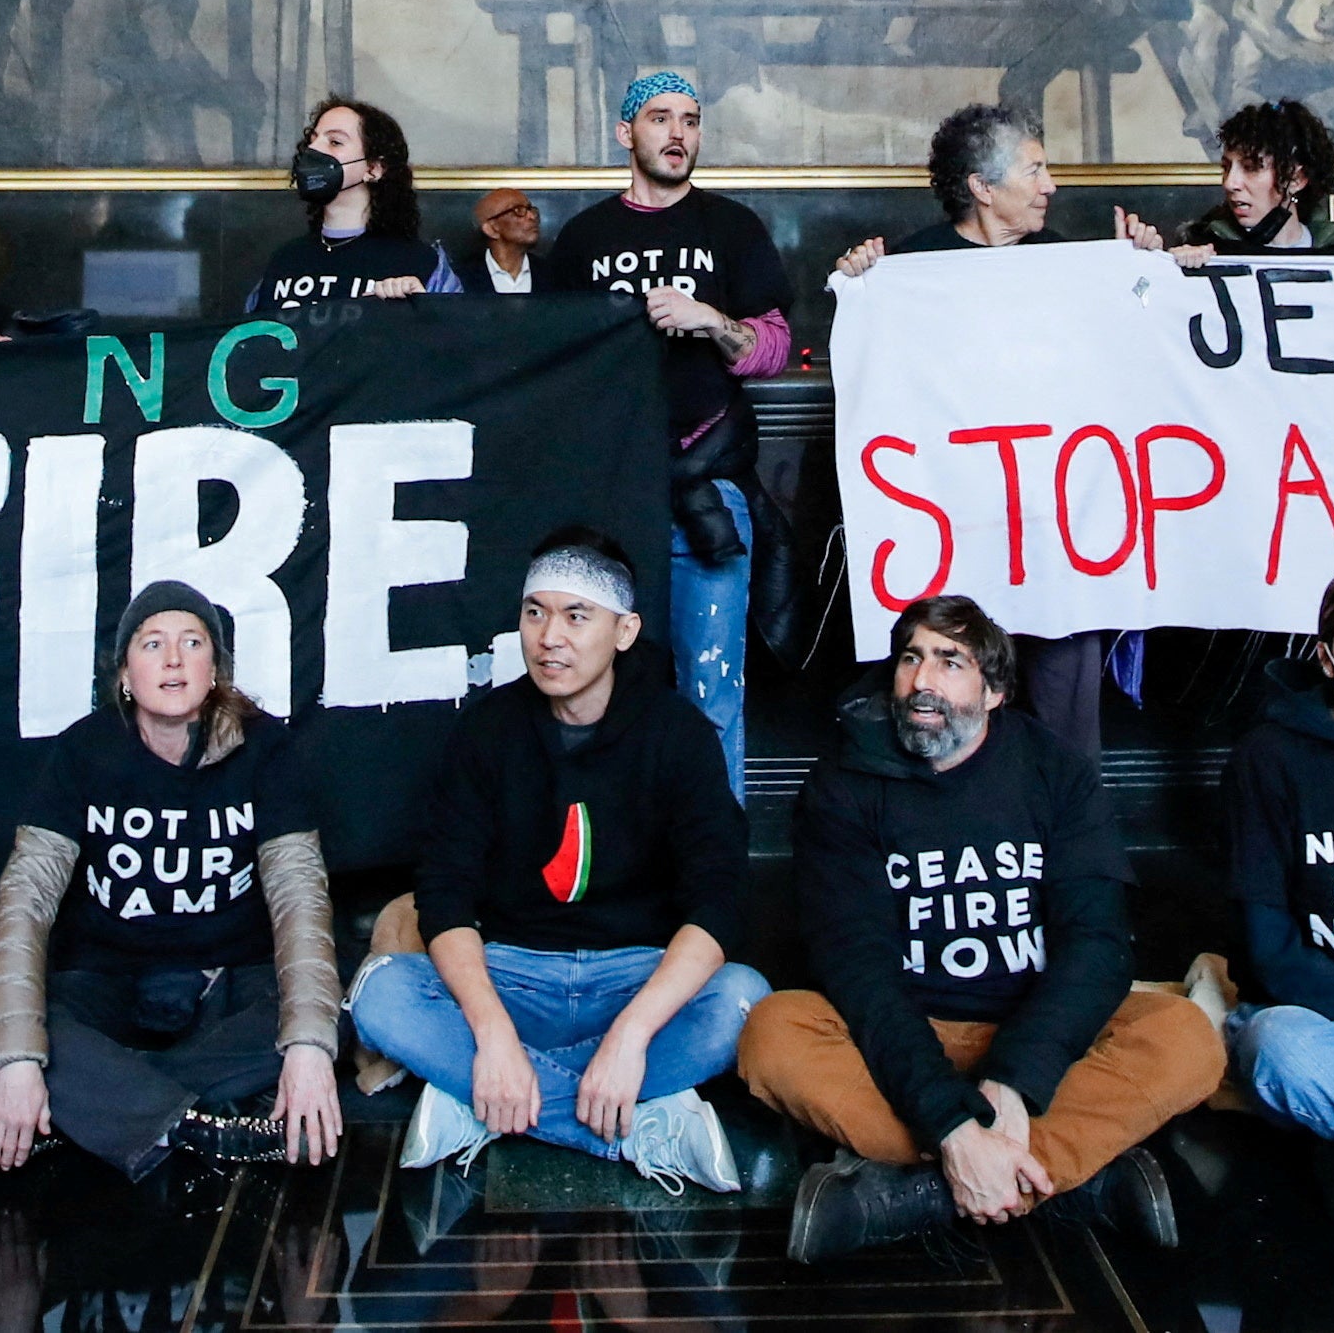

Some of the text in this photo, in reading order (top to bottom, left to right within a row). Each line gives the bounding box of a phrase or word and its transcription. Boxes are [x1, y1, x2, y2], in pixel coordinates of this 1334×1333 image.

[592, 247, 714, 281] NOT IN
[273, 275, 338, 301] NOT
[861, 423, 1226, 613] STOP
[87, 801, 255, 840] NOT IN
[107, 842, 234, 884] OUR
[885, 841, 1044, 890] CEASE
[86, 861, 254, 921] NAME
[908, 887, 1032, 931] FIRE
